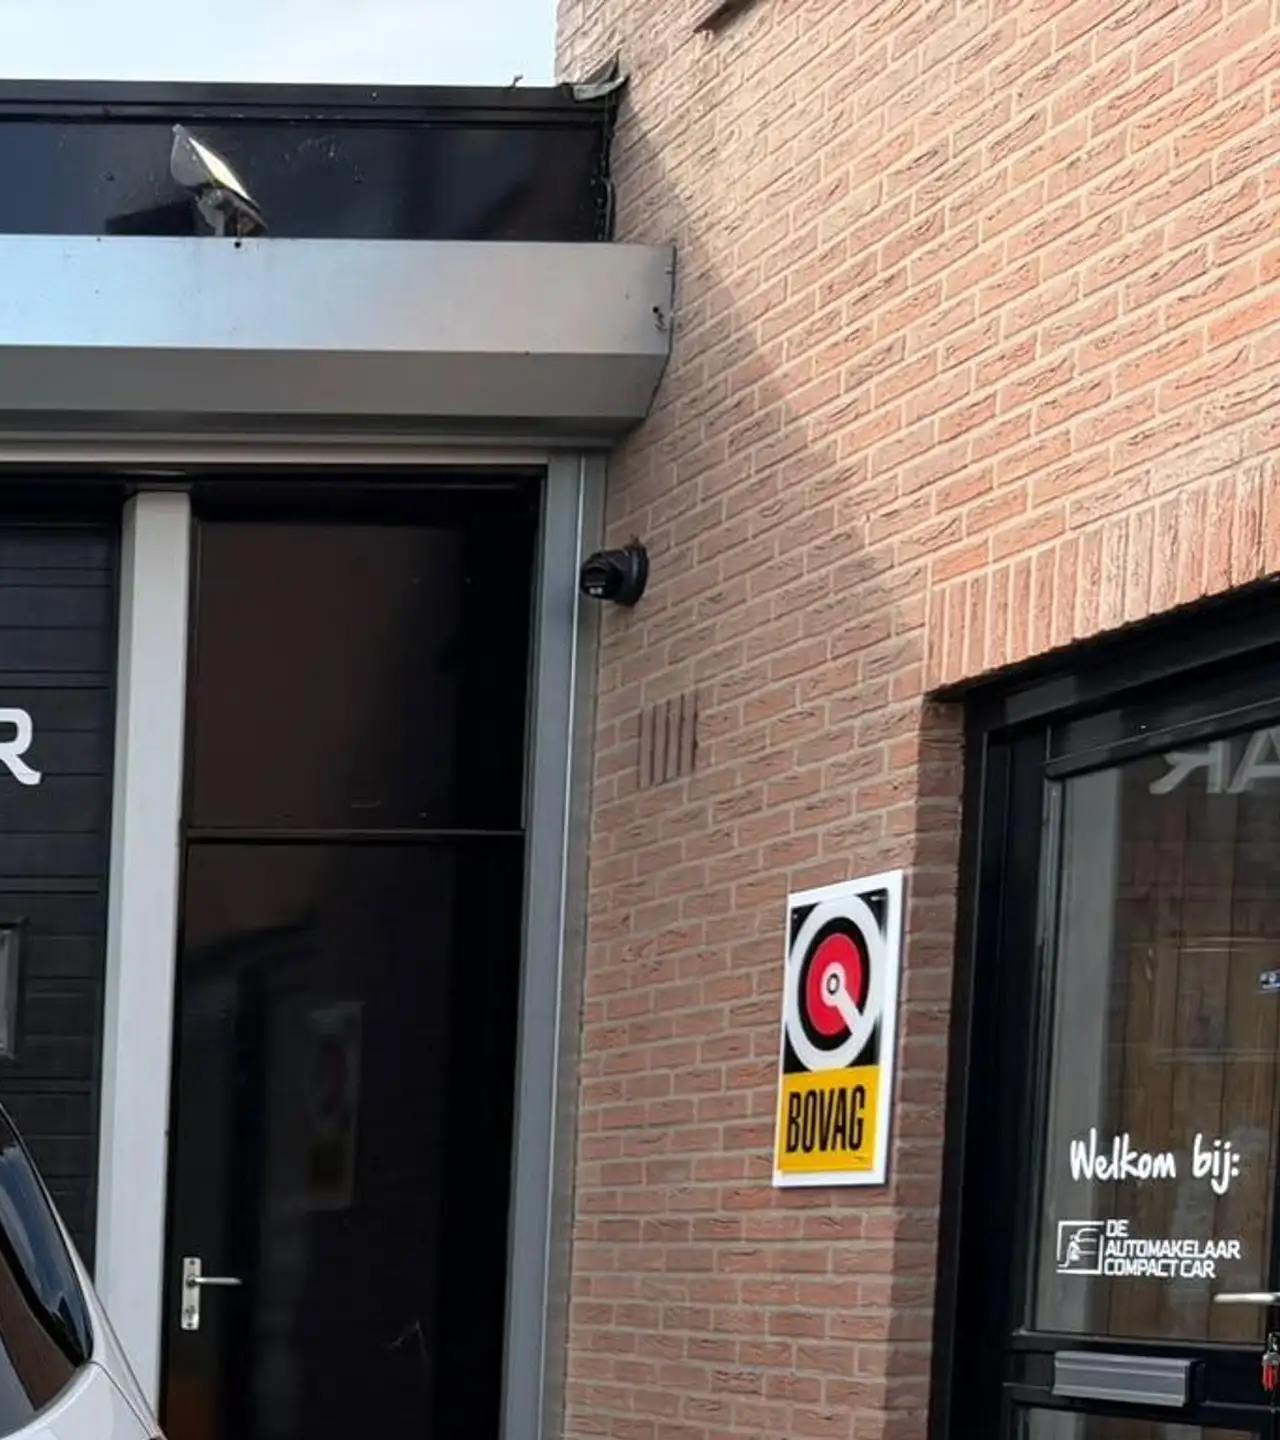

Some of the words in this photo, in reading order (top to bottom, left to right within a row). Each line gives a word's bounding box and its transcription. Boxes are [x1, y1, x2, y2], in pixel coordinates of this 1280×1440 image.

[785, 1084, 865, 1154] BOVAG
[1070, 1127, 1176, 1181] Welkom
[1192, 1133, 1240, 1195] bij:
[1106, 1219, 1129, 1238] DE
[1105, 1239, 1241, 1260] AUTOMAKELAAR
[1104, 1258, 1179, 1278] COMPACT
[1180, 1259, 1216, 1279] CAR
